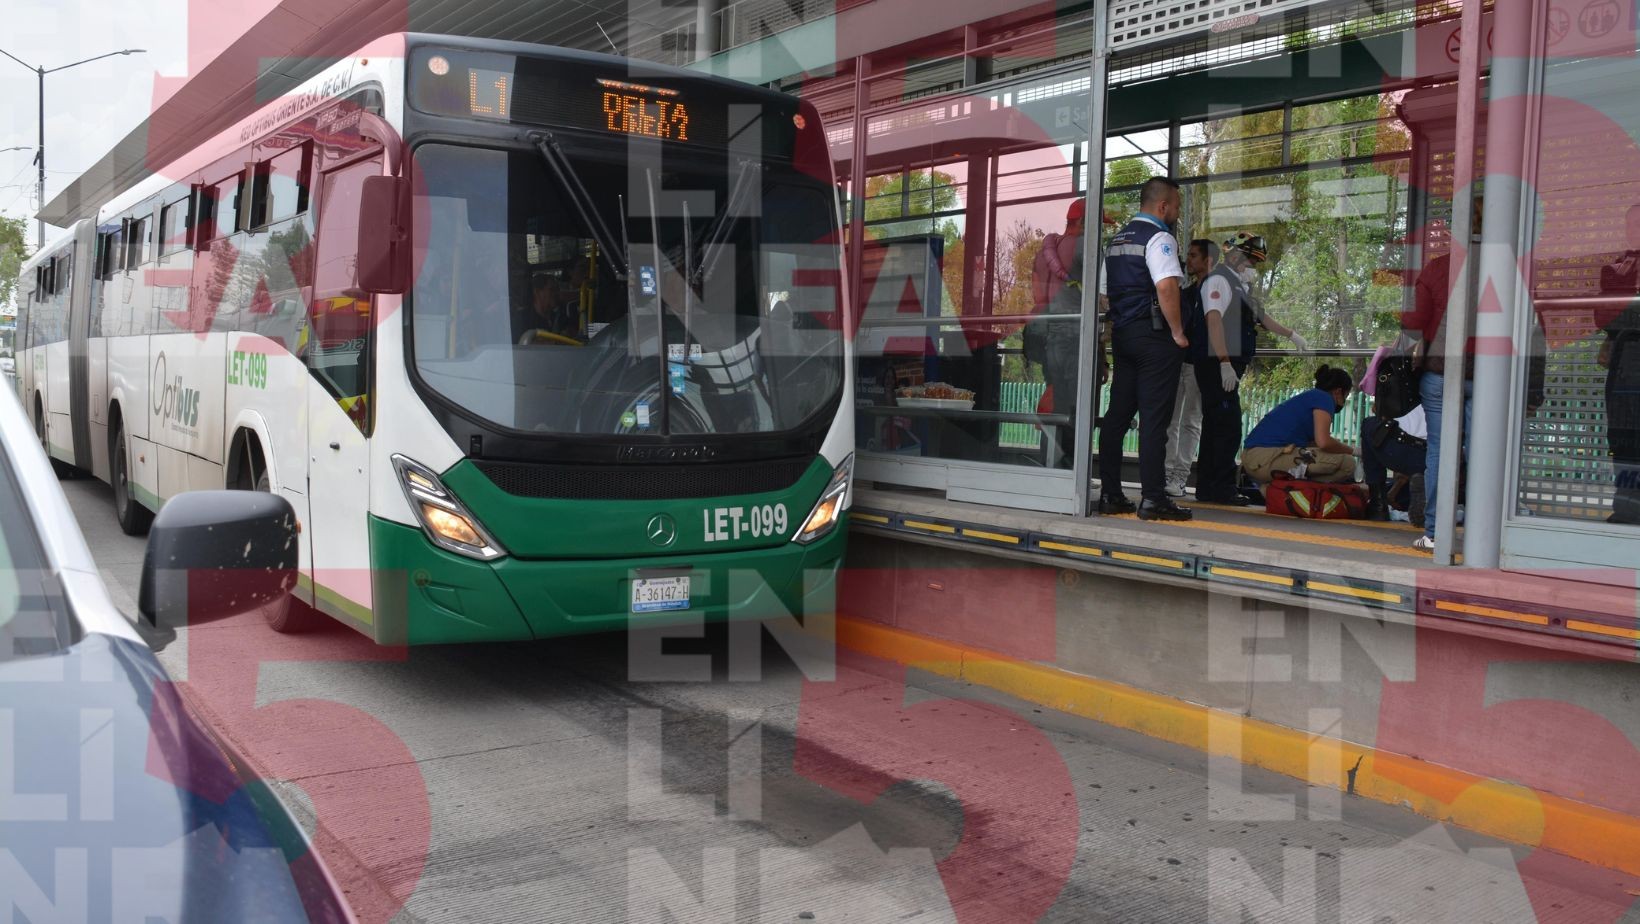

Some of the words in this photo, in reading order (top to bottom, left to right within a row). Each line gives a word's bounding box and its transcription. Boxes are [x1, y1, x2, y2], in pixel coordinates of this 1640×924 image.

[277, 92, 305, 121] ORIENTE
[320, 78, 333, 100] DE
[469, 71, 508, 116] L1
[603, 91, 690, 125] DELTA
[227, 350, 267, 390] LET-099
[703, 503, 788, 543] LET-099
[634, 585, 689, 603] A-36147-H
